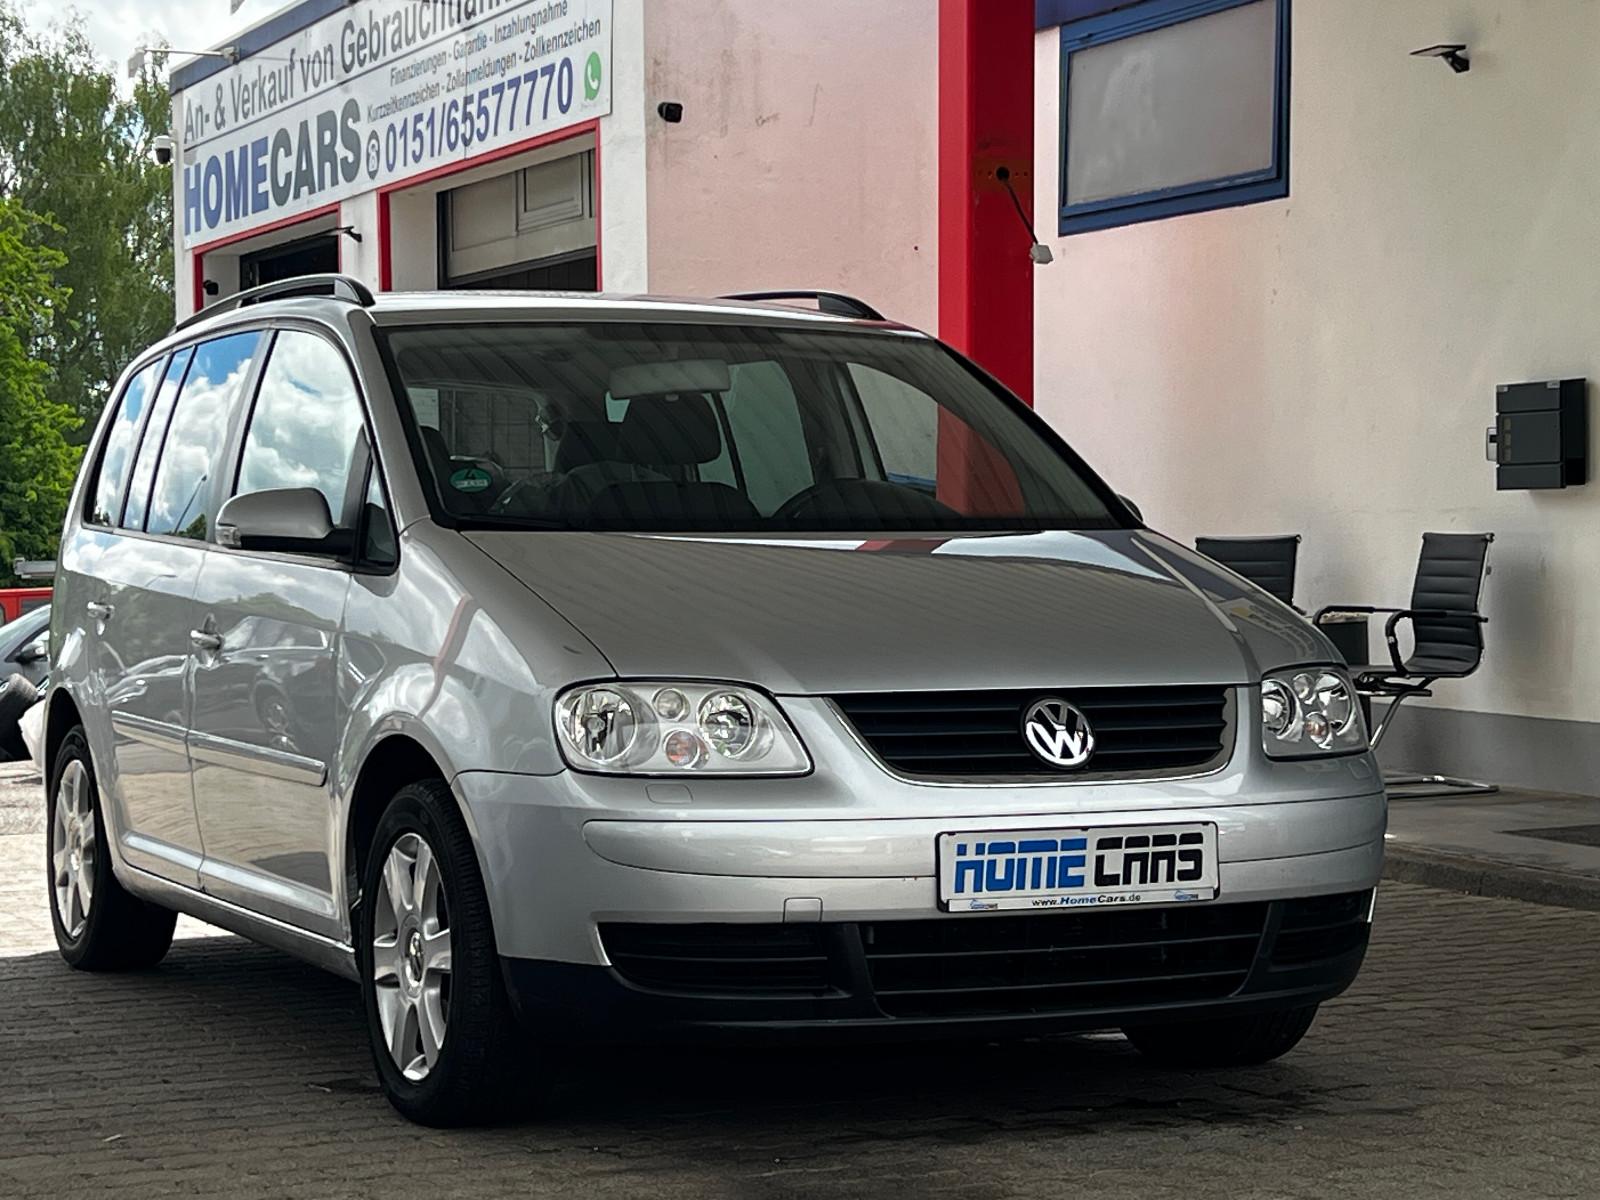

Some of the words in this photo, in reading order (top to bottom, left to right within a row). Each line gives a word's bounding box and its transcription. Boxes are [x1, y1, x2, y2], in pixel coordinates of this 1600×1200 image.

[184, 97, 210, 144] An-
[214, 83, 226, 131] &
[230, 48, 296, 123] Verkauf
[300, 43, 334, 92] von
[367, 82, 440, 123] Kurzzeitkennzeichen
[446, 52, 517, 93] Zollanmeldungen
[524, 18, 601, 63] Zollkennzeichen
[390, 51, 447, 87] Finanzierungen
[453, 30, 487, 60] Garantie
[494, 0, 568, 43] Inzahlungnahme
[385, 57, 573, 172] 0151/65577770
[184, 98, 362, 236] HOMECARS
[954, 837, 1088, 893] HOME
[1094, 832, 1204, 887] CARS
[1032, 893, 1141, 907] www.HomeCars.de
